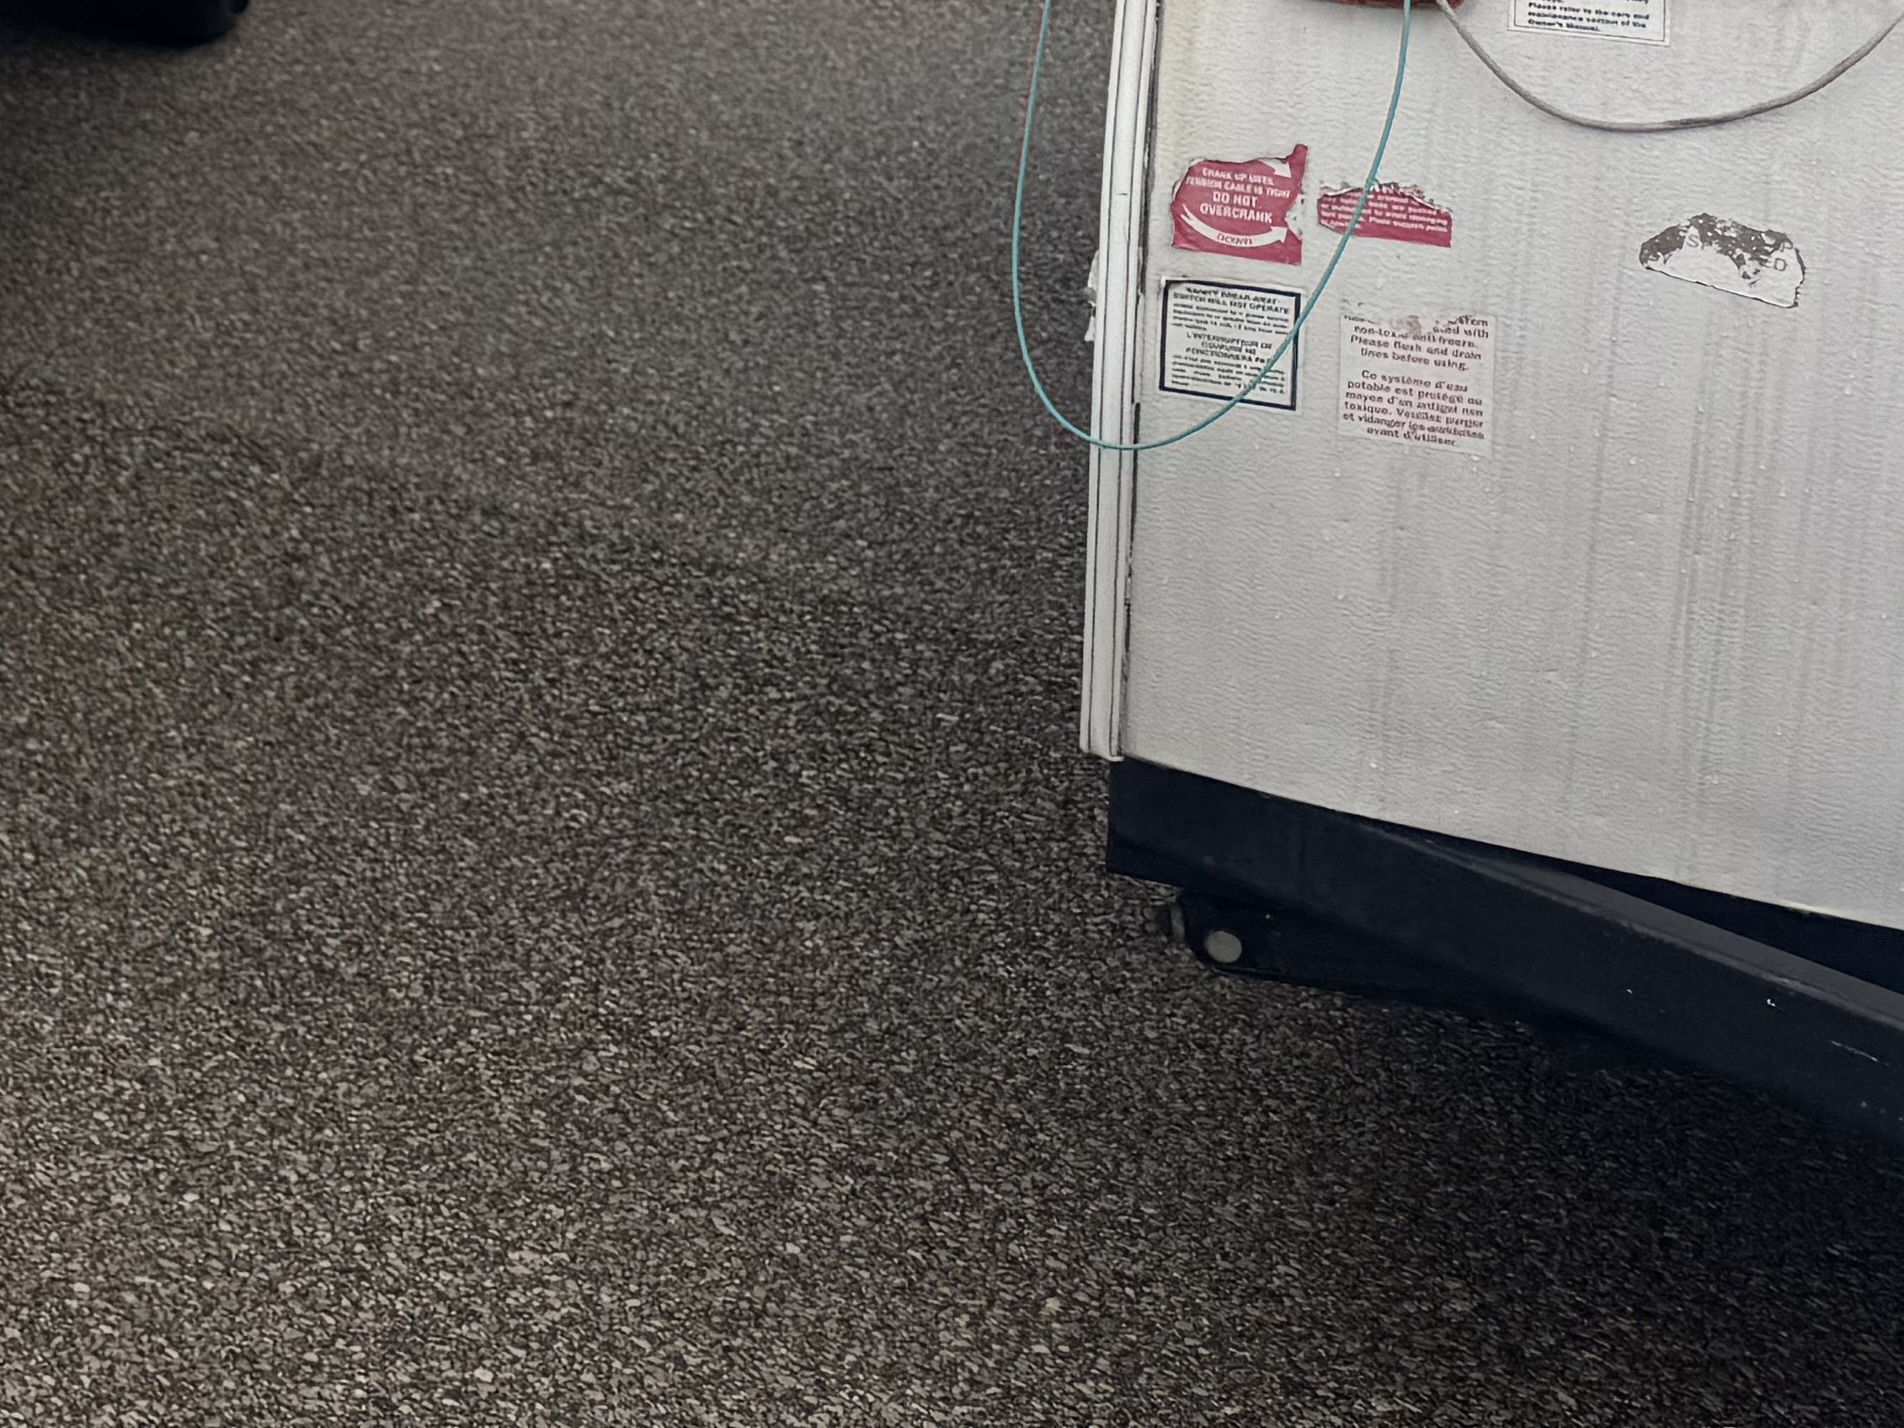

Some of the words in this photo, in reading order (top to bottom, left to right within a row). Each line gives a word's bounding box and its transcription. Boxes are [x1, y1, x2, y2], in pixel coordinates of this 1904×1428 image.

[1202, 167, 1232, 180] CRANK
[1224, 181, 1252, 194] CABLE
[1212, 191, 1230, 204] DO
[1233, 194, 1259, 208] NOT
[1199, 203, 1273, 224] OVERCRANK
[1249, 302, 1290, 314] OPERATE
[1350, 335, 1390, 349] Please
[1426, 346, 1448, 356] and
[1392, 351, 1430, 365] before
[1347, 380, 1391, 393] potable
[1394, 387, 1414, 397] est
[1342, 412, 1354, 422] et
[1366, 426, 1399, 439] avant
